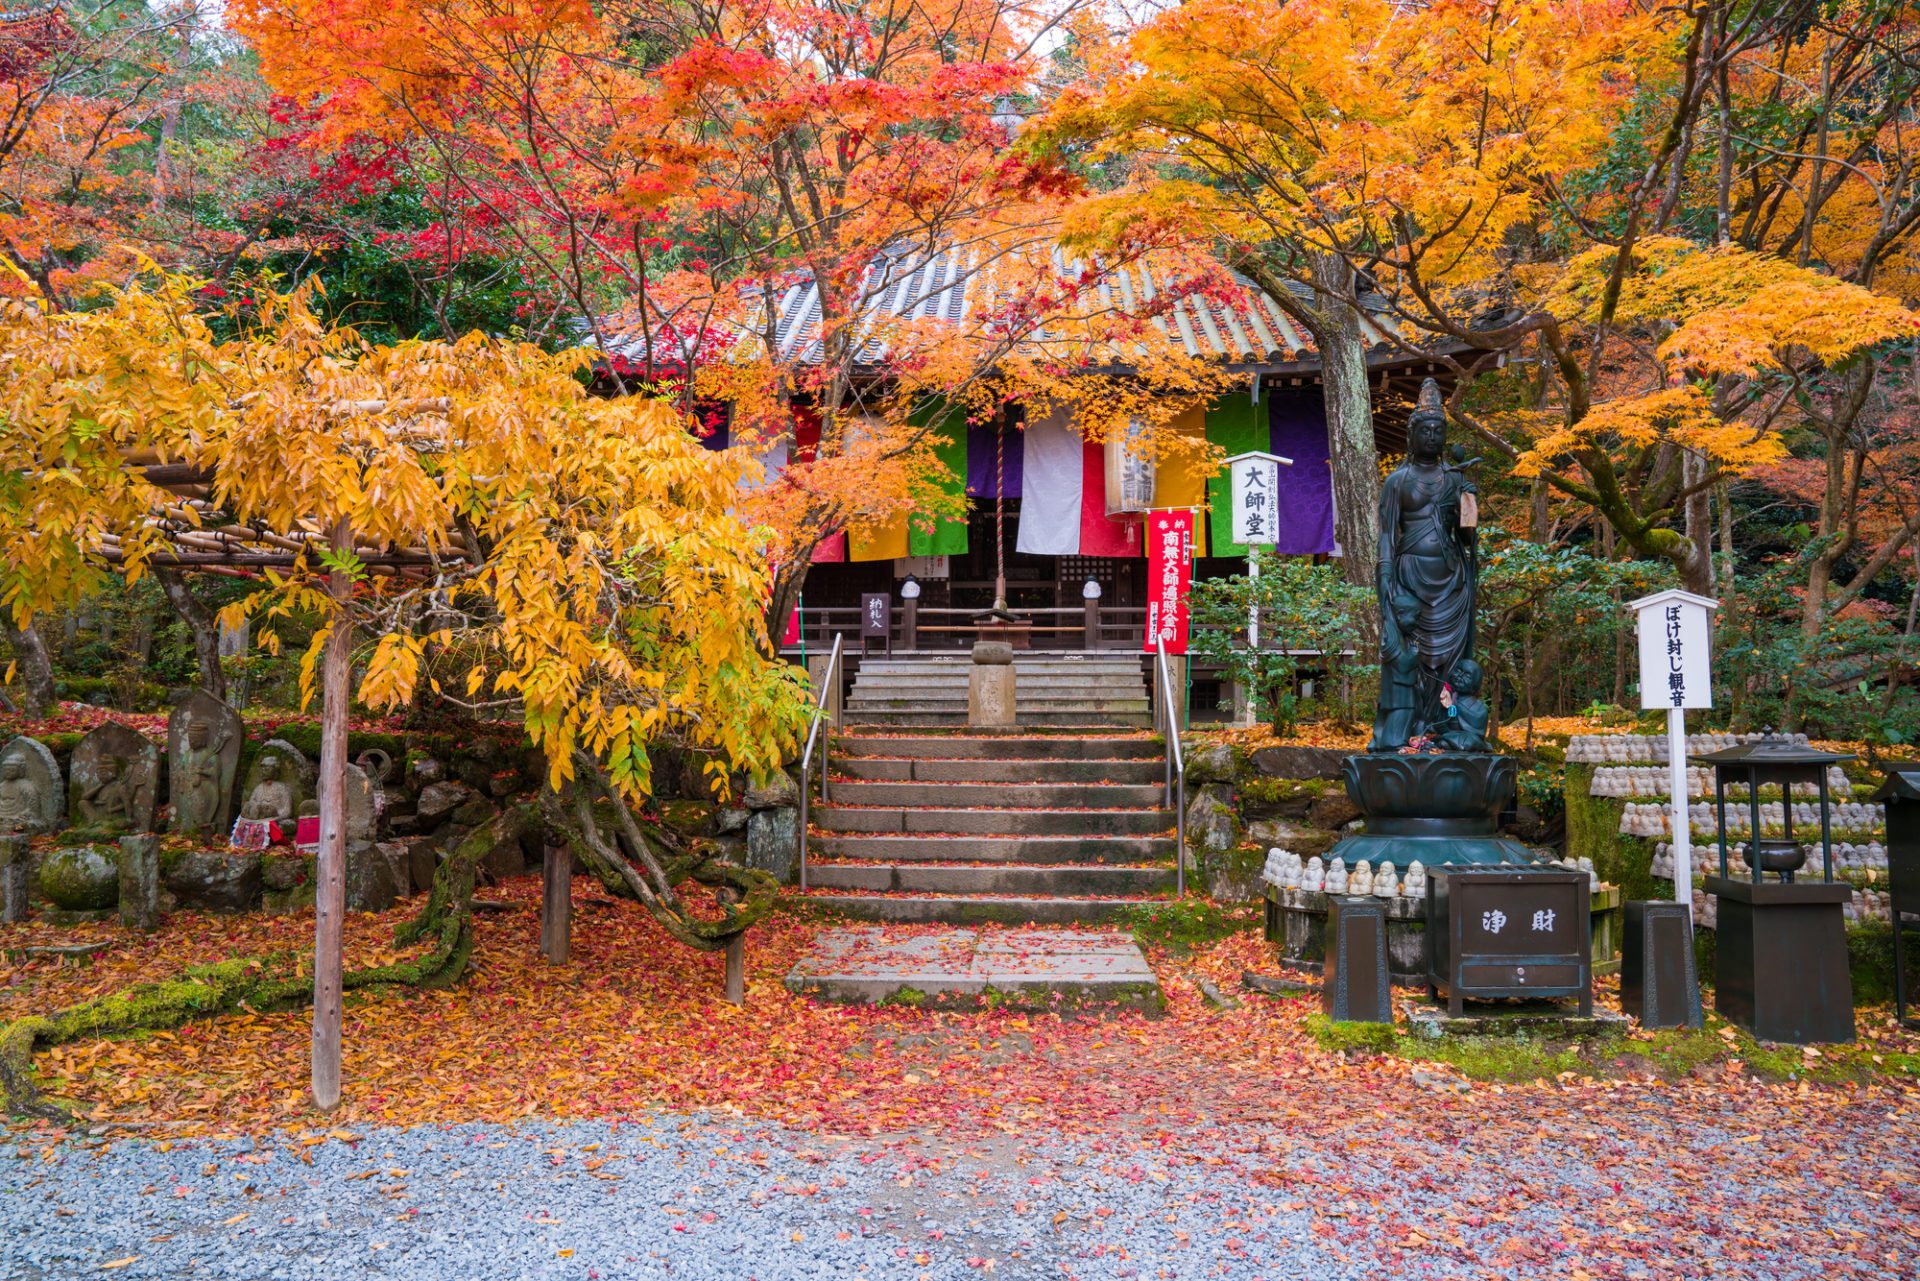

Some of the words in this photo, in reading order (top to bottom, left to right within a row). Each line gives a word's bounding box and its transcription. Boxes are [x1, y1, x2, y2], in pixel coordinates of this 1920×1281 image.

[1158, 519, 1185, 530] 奉納
[1244, 466, 1266, 537] 大師堂
[1161, 531, 1179, 641] 南無大師遍照金剛
[869, 598, 883, 628] 納札入
[1666, 604, 1685, 707] ぼけ封じ観音
[1482, 908, 1556, 934] 浄財
